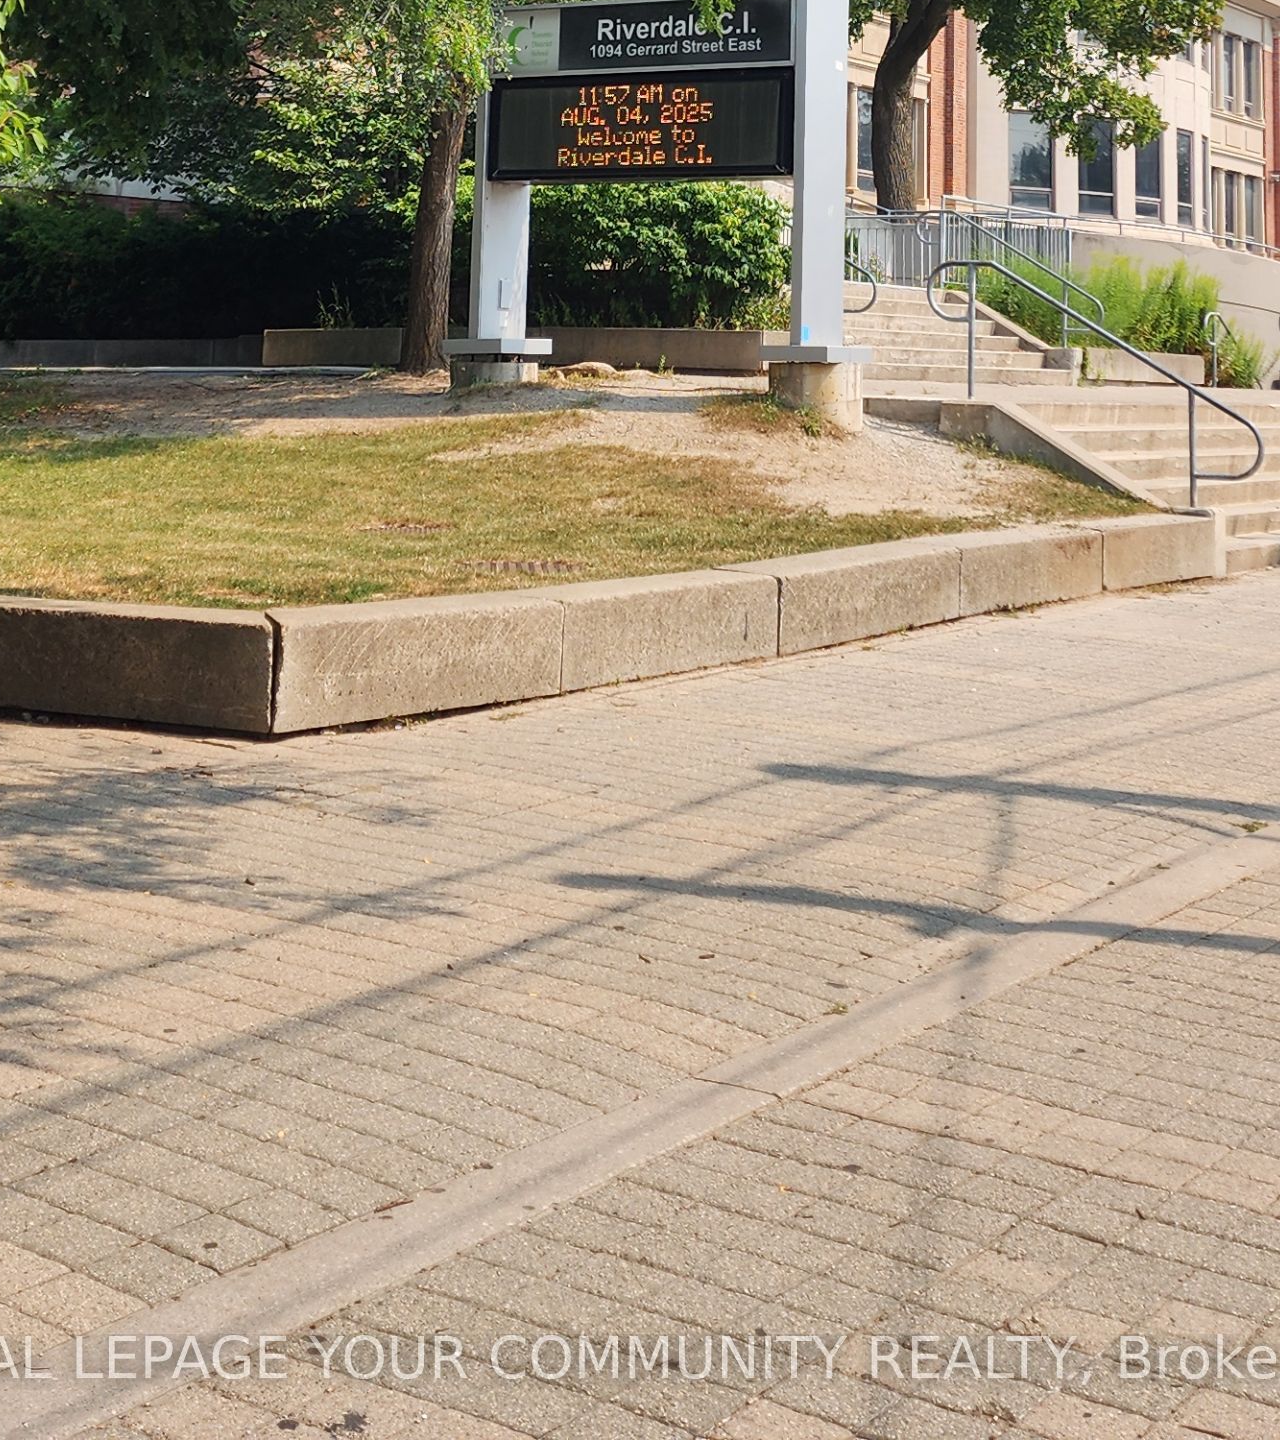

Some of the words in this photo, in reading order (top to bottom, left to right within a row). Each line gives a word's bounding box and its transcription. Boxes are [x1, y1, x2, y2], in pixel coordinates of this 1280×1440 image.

[718, 11, 757, 35] C.I.
[589, 44, 623, 58] 1094
[626, 41, 678, 57] Gerrard
[681, 39, 724, 54] Street
[728, 37, 762, 52] East
[578, 85, 631, 106] 11:57
[636, 84, 663, 104] AM
[672, 87, 698, 103] on
[561, 106, 606, 127] AUG.
[616, 105, 650, 125] 04,
[660, 102, 714, 124] 2025
[671, 125, 695, 143] to
[557, 146, 666, 167] Riverdale
[674, 144, 713, 165] C.I.
